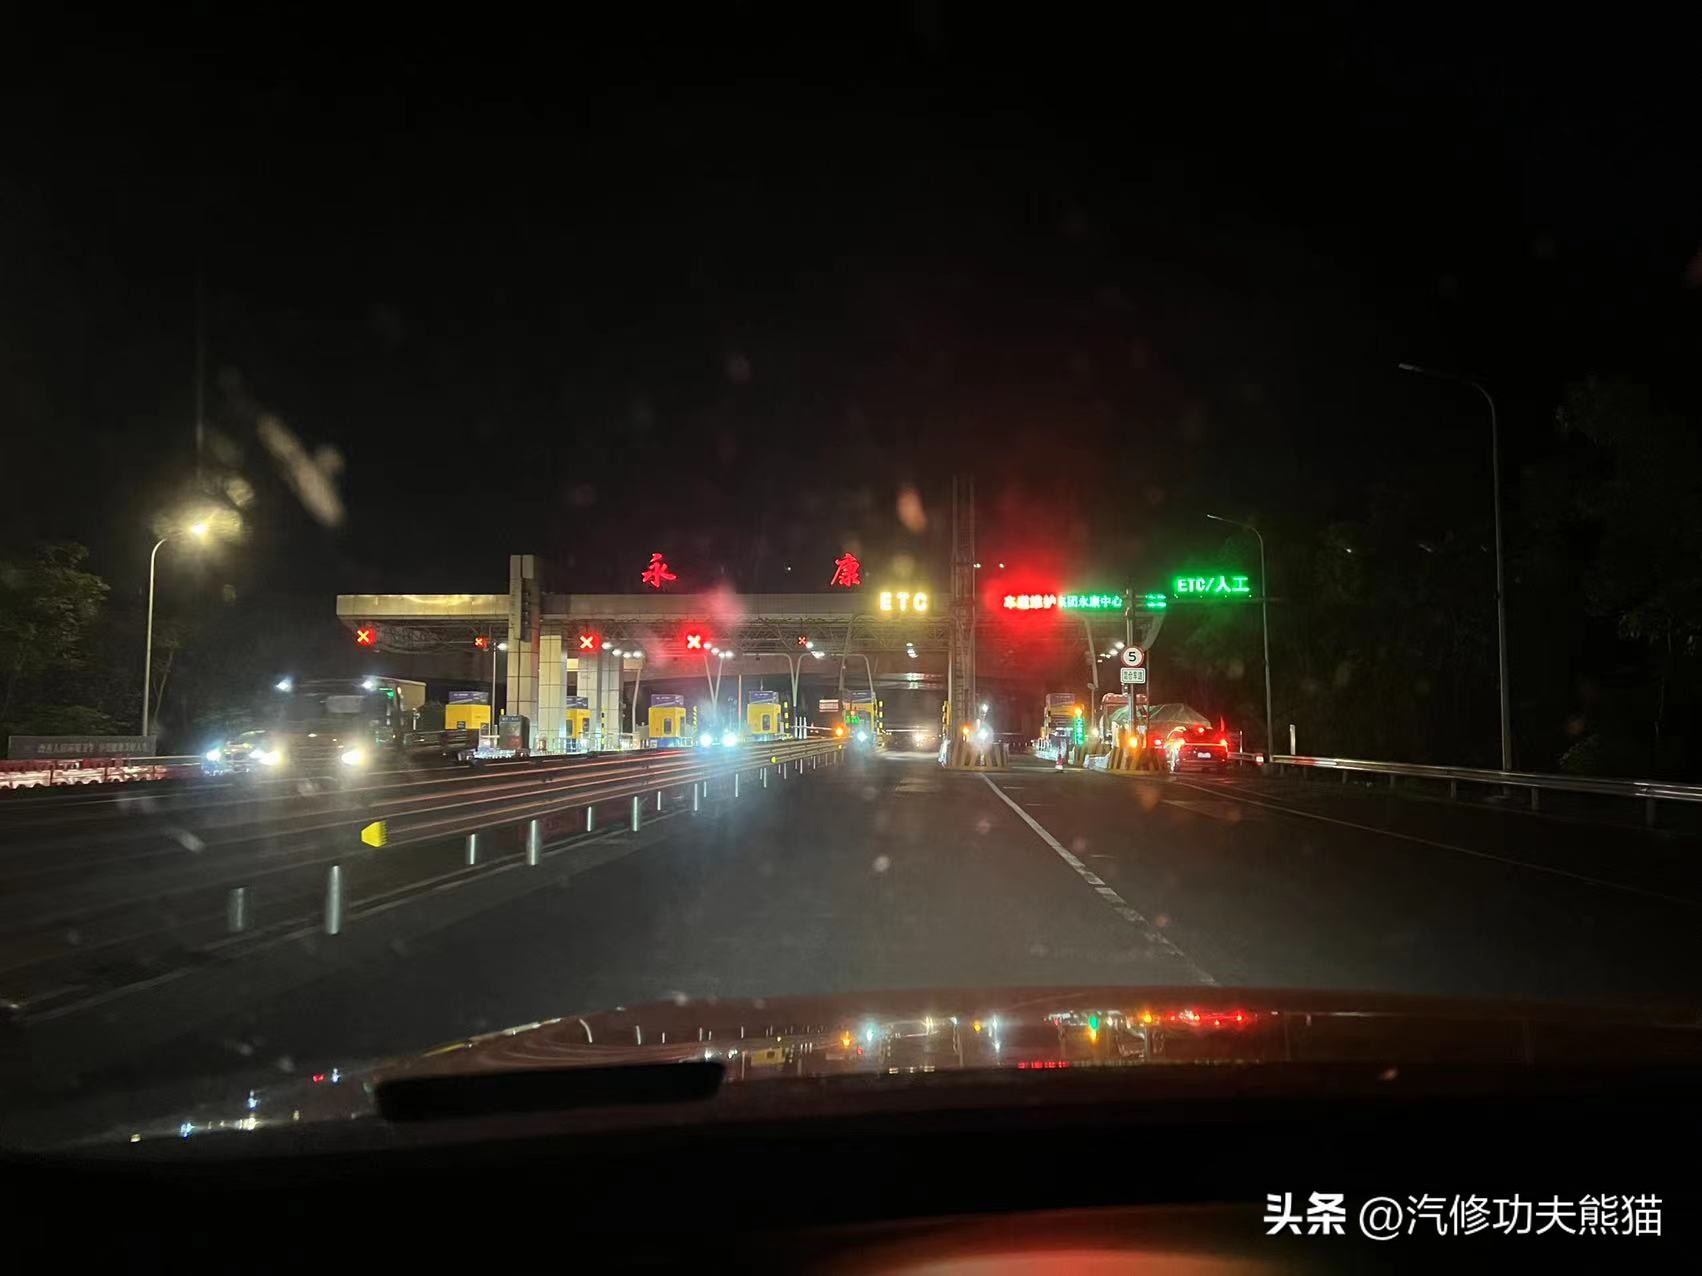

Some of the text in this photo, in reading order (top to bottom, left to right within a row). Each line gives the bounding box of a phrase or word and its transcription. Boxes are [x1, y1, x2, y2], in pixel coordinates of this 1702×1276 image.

[641, 552, 862, 588] 永 康
[1177, 575, 1250, 593] ETC/人工
[879, 591, 928, 612] ETC
[1128, 651, 1137, 662] 5
